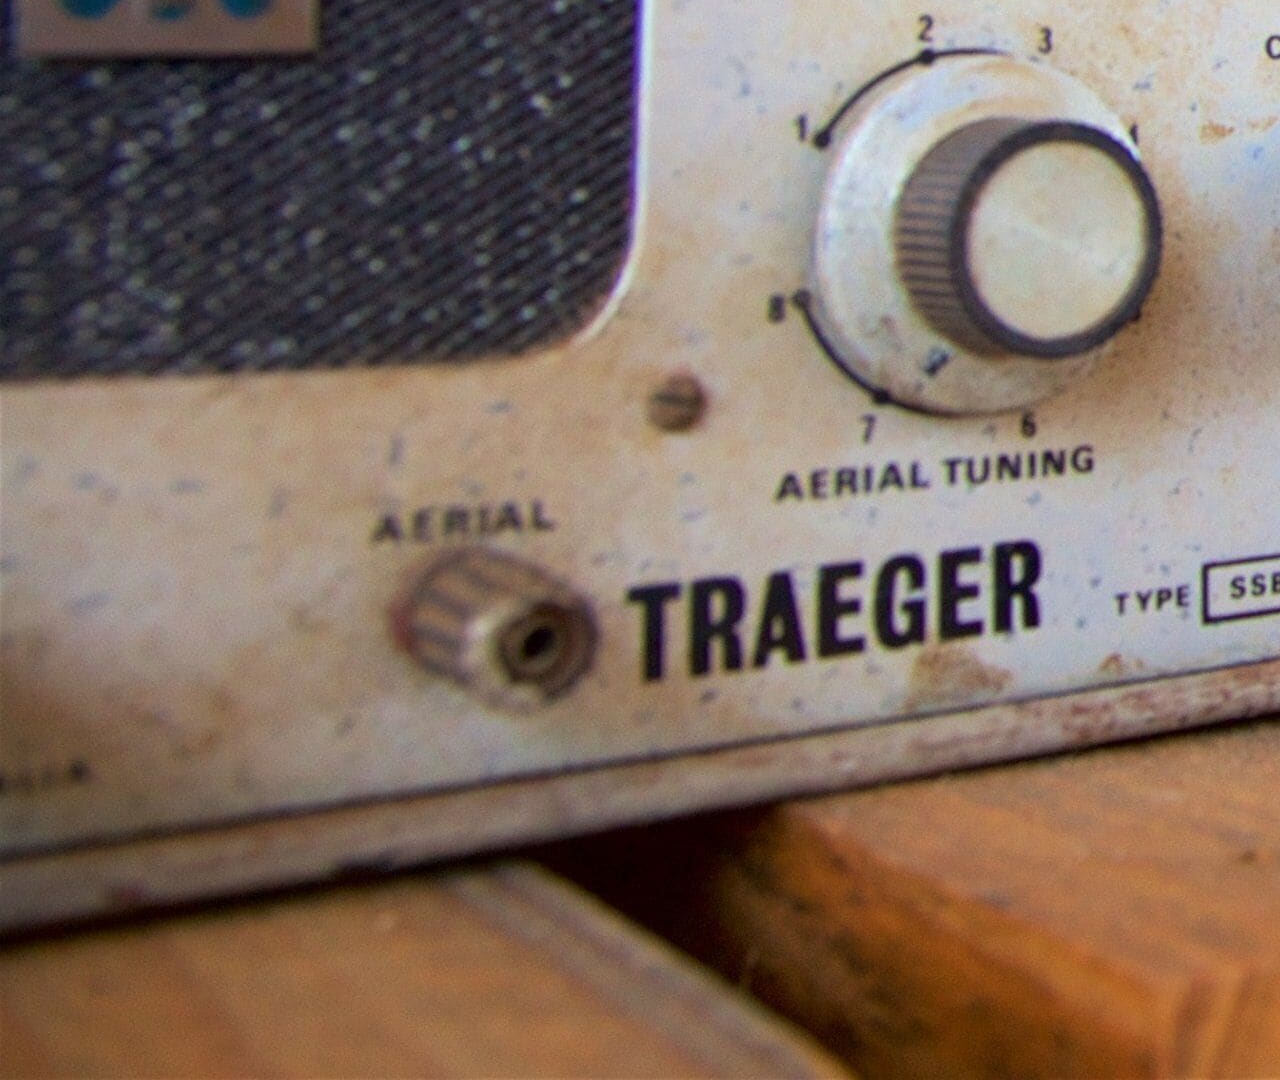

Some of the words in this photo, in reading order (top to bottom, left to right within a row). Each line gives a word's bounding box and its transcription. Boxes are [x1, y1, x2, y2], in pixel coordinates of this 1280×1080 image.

[917, 14, 935, 42] 2
[1037, 27, 1053, 54] 3
[775, 459, 930, 503] AERIAL
[943, 443, 1096, 485] TUNING
[371, 498, 558, 544] AERIAL
[626, 539, 1043, 683] TRAEGER
[1114, 584, 1191, 615] TYPE
